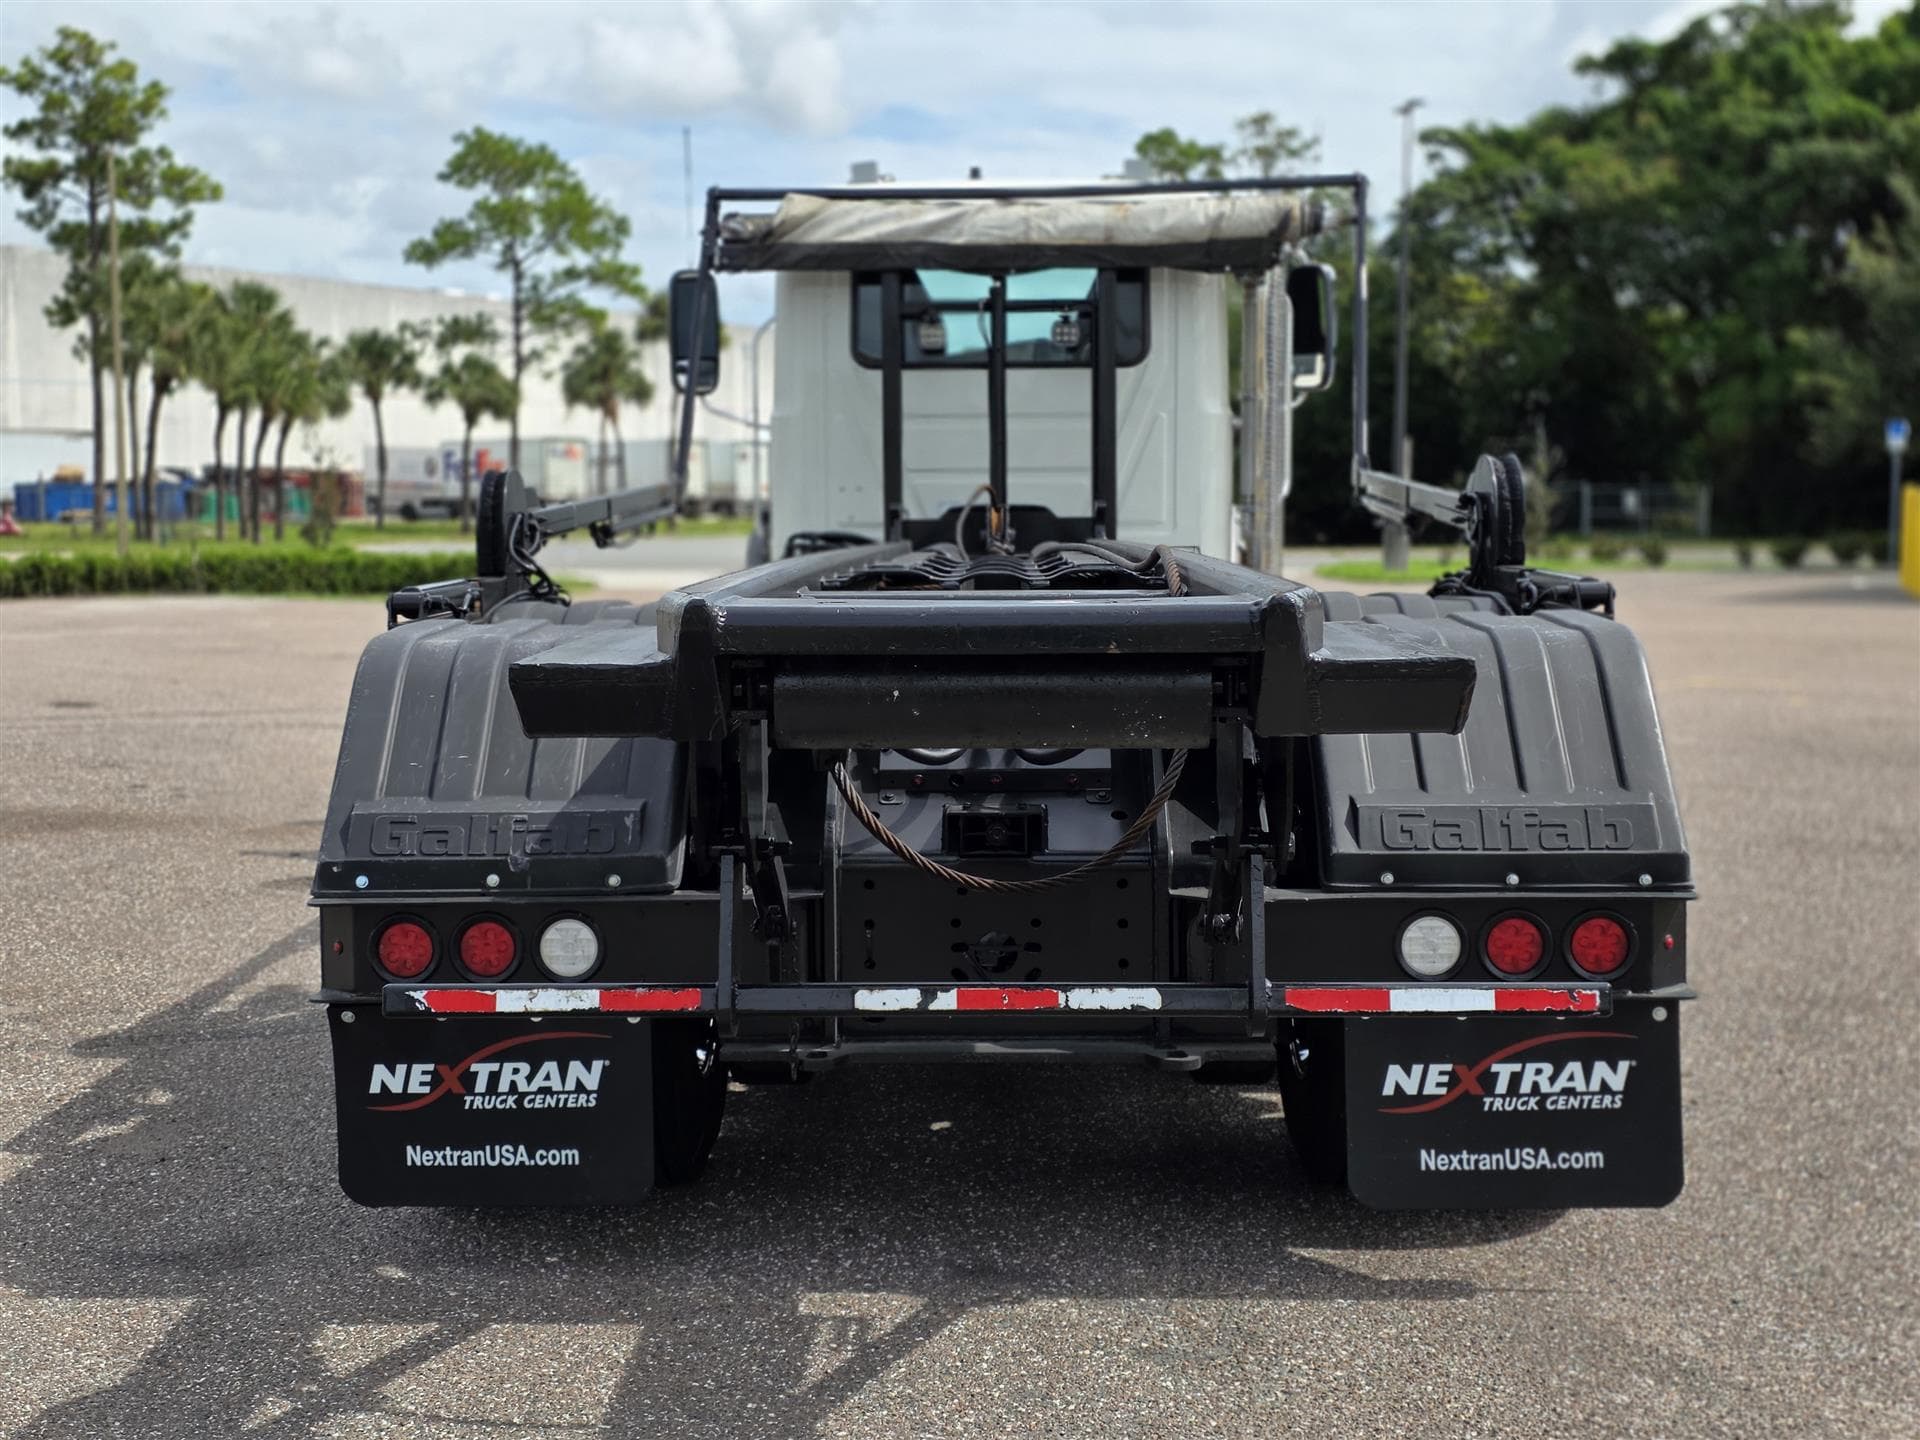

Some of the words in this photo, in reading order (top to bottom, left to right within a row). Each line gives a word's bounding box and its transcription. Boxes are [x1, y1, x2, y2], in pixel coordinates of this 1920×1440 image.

[369, 814, 617, 857] Galfab
[1379, 807, 1635, 852] Galfab
[463, 1094, 518, 1110] TRUCK
[523, 1092, 598, 1109] CENTERS
[1482, 1096, 1540, 1112] TRUCK
[1545, 1094, 1624, 1111] CENTERS
[405, 1144, 581, 1168] NextranUSA.com
[1419, 1147, 1606, 1172] NextranUSA.com
